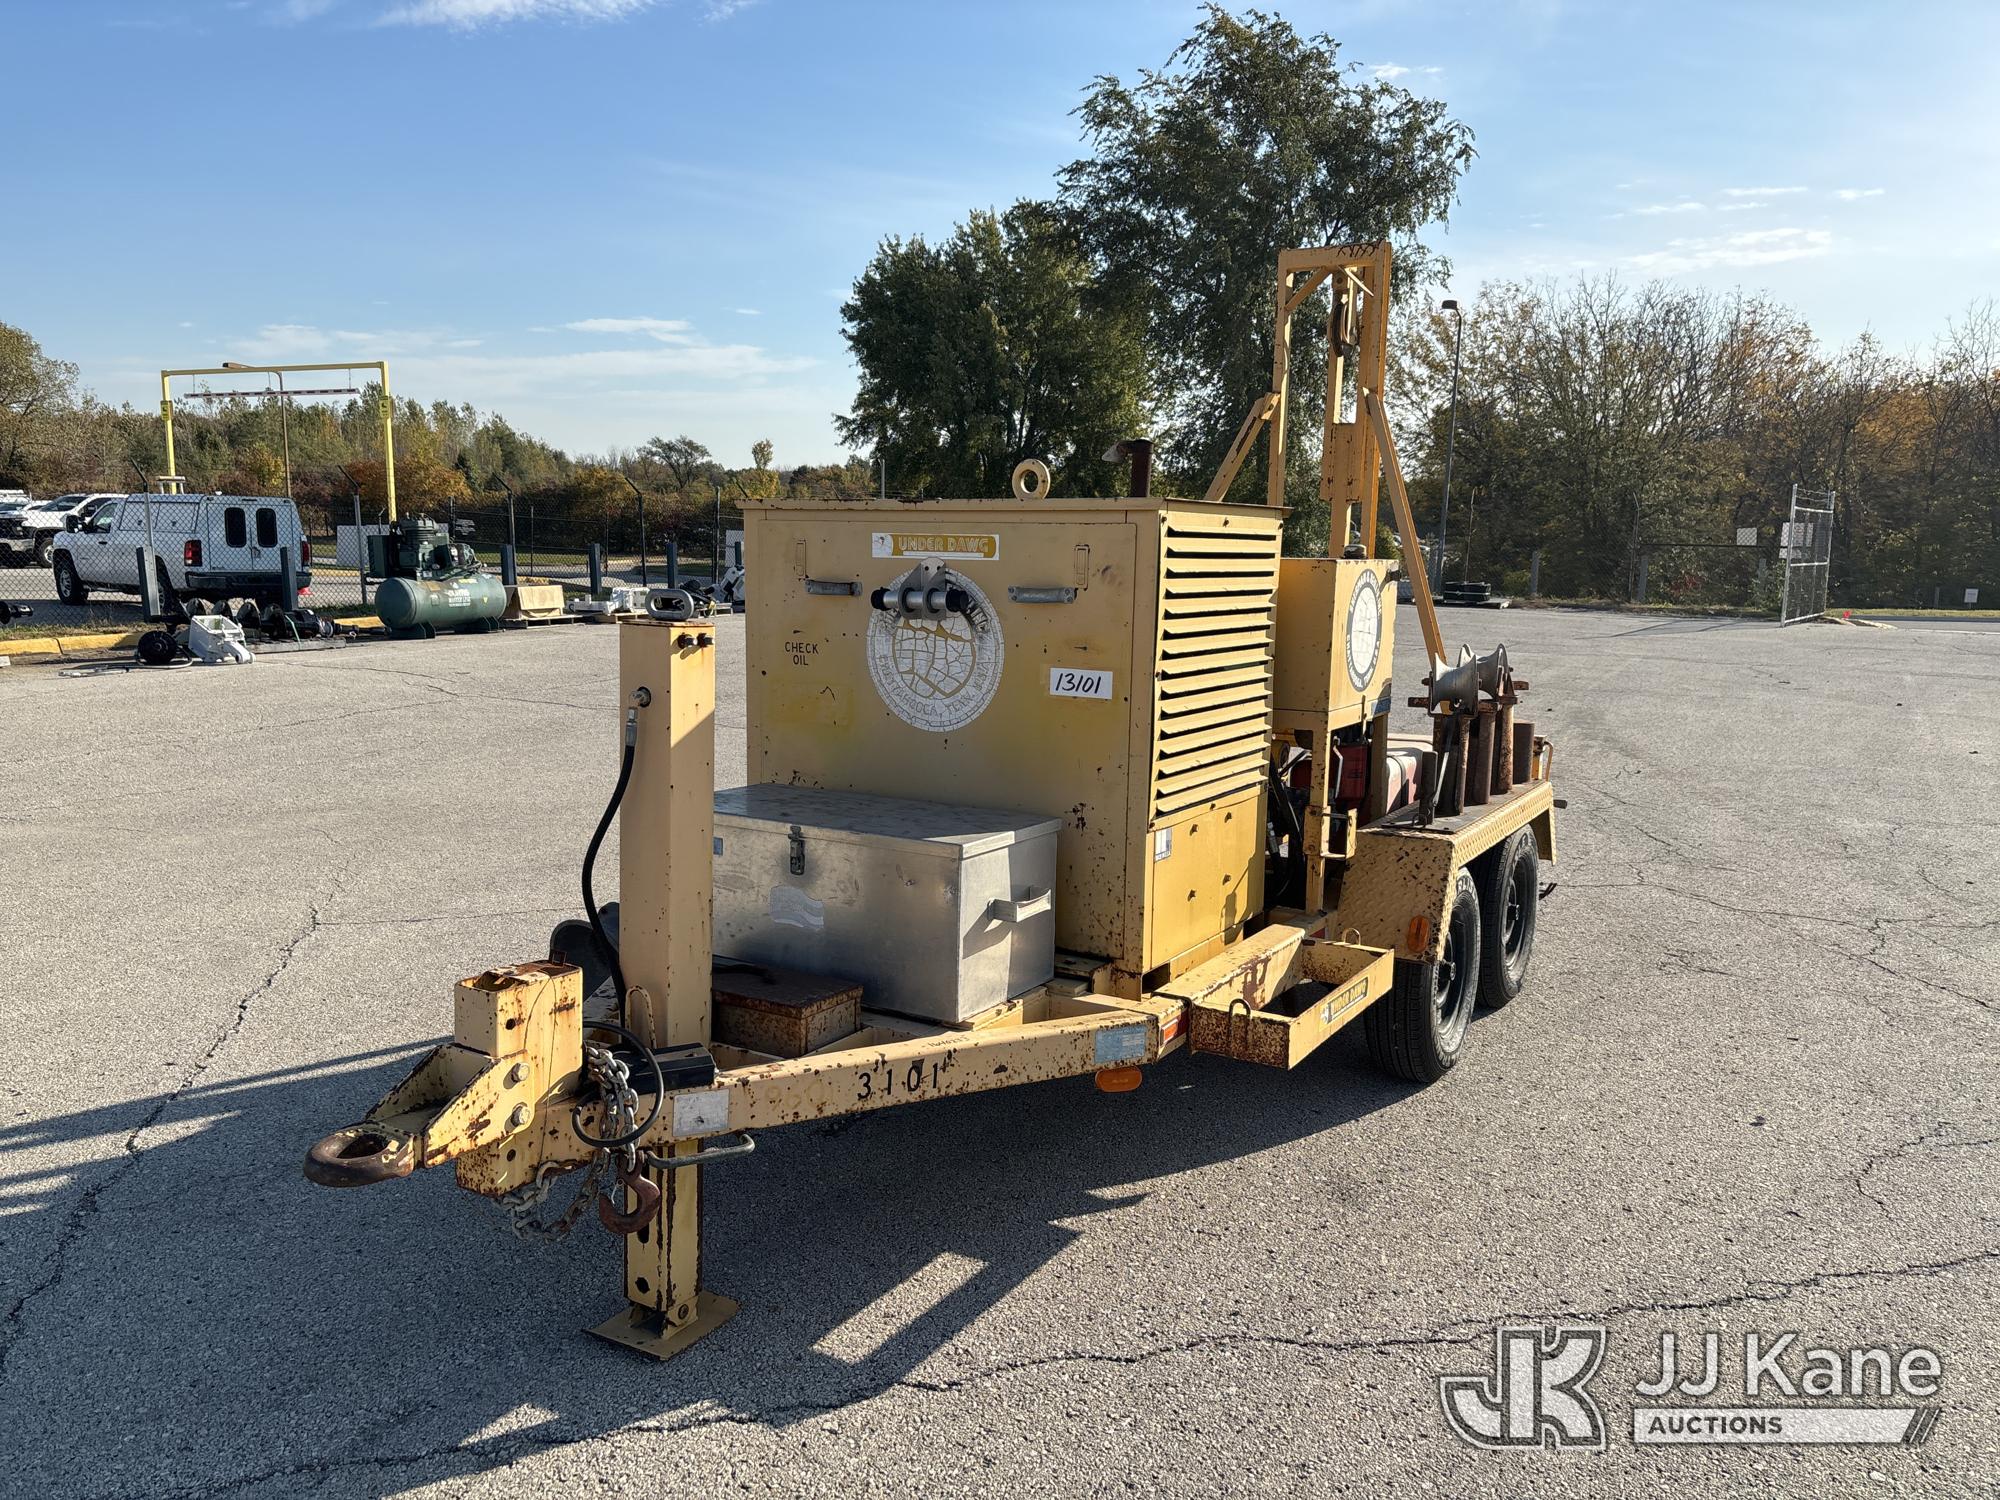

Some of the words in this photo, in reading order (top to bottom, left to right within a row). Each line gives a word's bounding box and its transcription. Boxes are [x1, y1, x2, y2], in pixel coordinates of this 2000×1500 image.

[898, 535, 944, 551] UNDER
[947, 537, 989, 553] DAWG
[784, 641, 819, 654] CHECK
[792, 654, 809, 666] OIL
[1054, 671, 1102, 695] 13101
[856, 1061, 939, 1099] 3101
